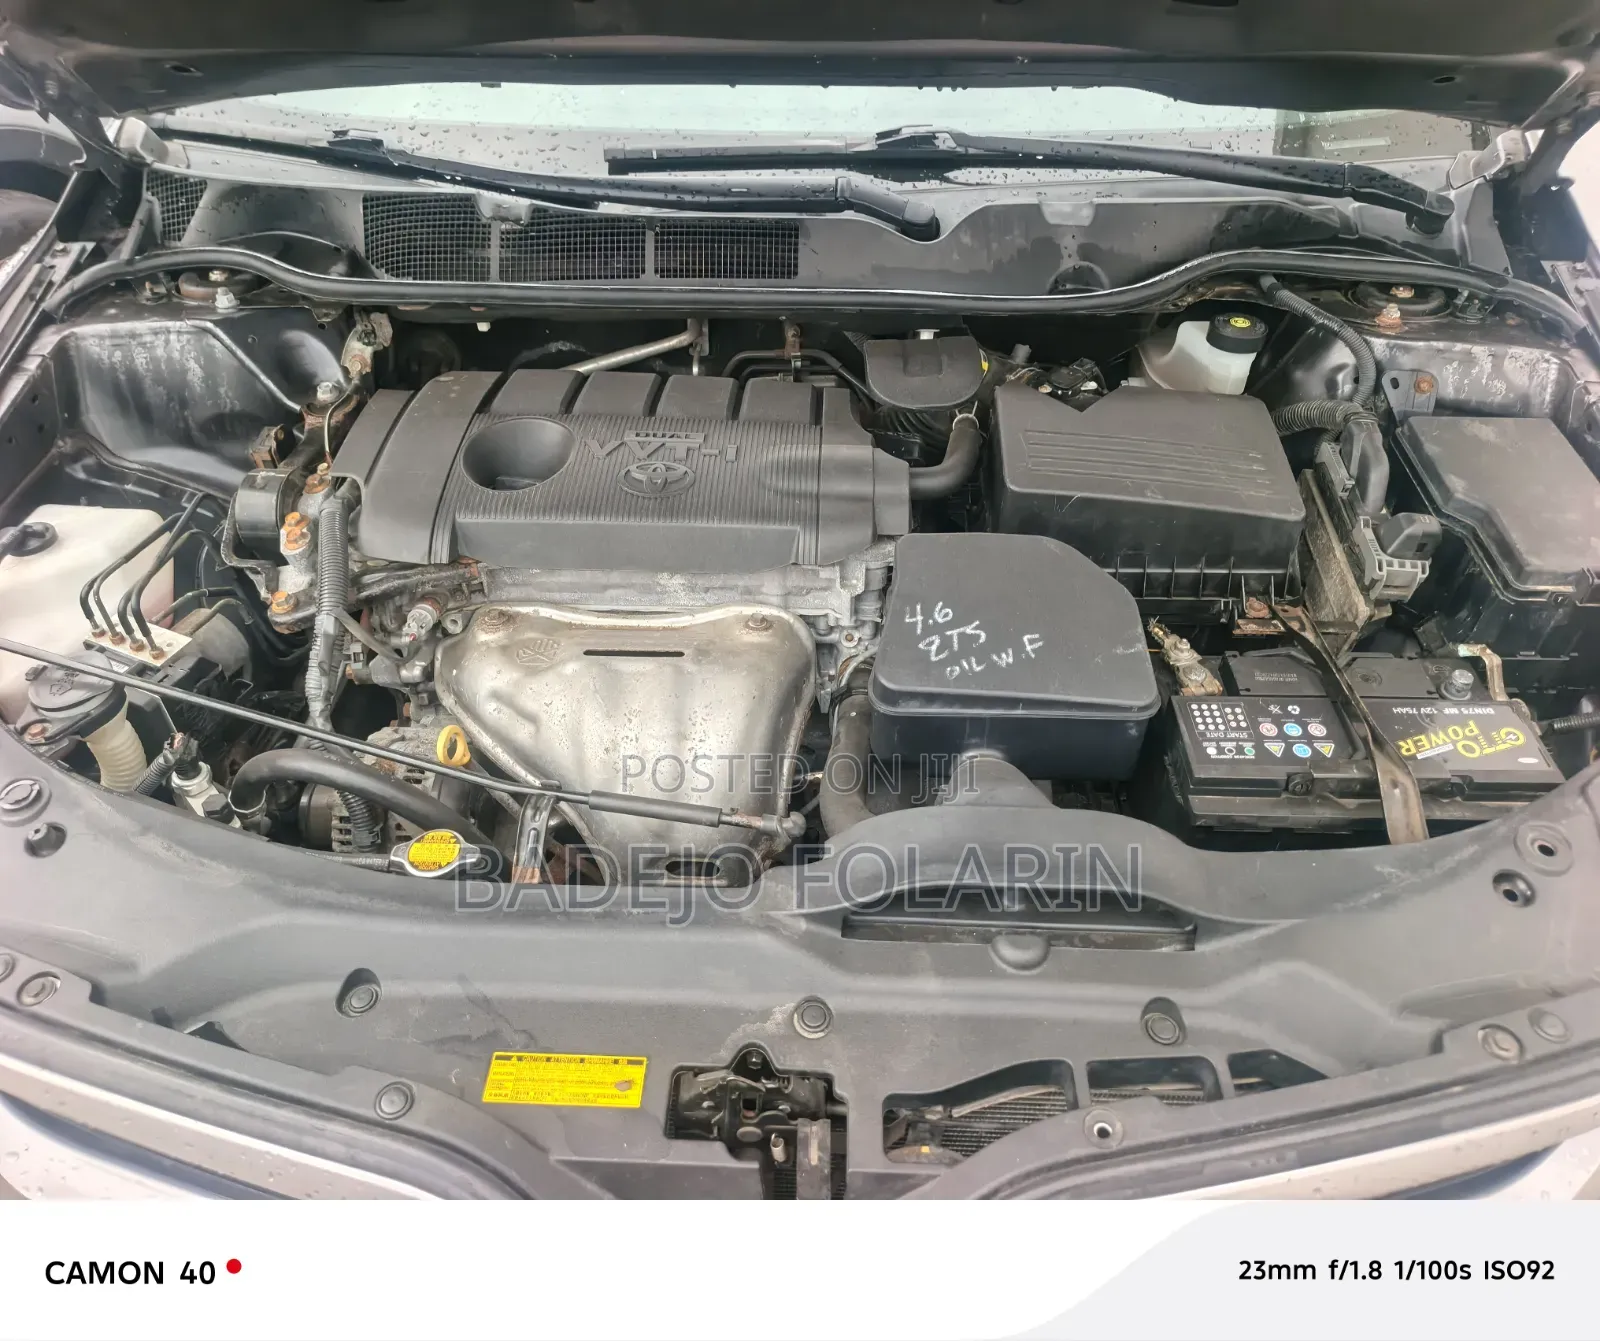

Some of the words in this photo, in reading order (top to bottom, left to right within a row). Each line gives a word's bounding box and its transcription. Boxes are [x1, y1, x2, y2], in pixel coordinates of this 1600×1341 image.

[904, 601, 953, 635] 4.6
[1420, 706, 1438, 715] 12V
[1442, 707, 1459, 715] MF
[1460, 707, 1496, 715] DIN75
[1396, 719, 1480, 757] POWER
